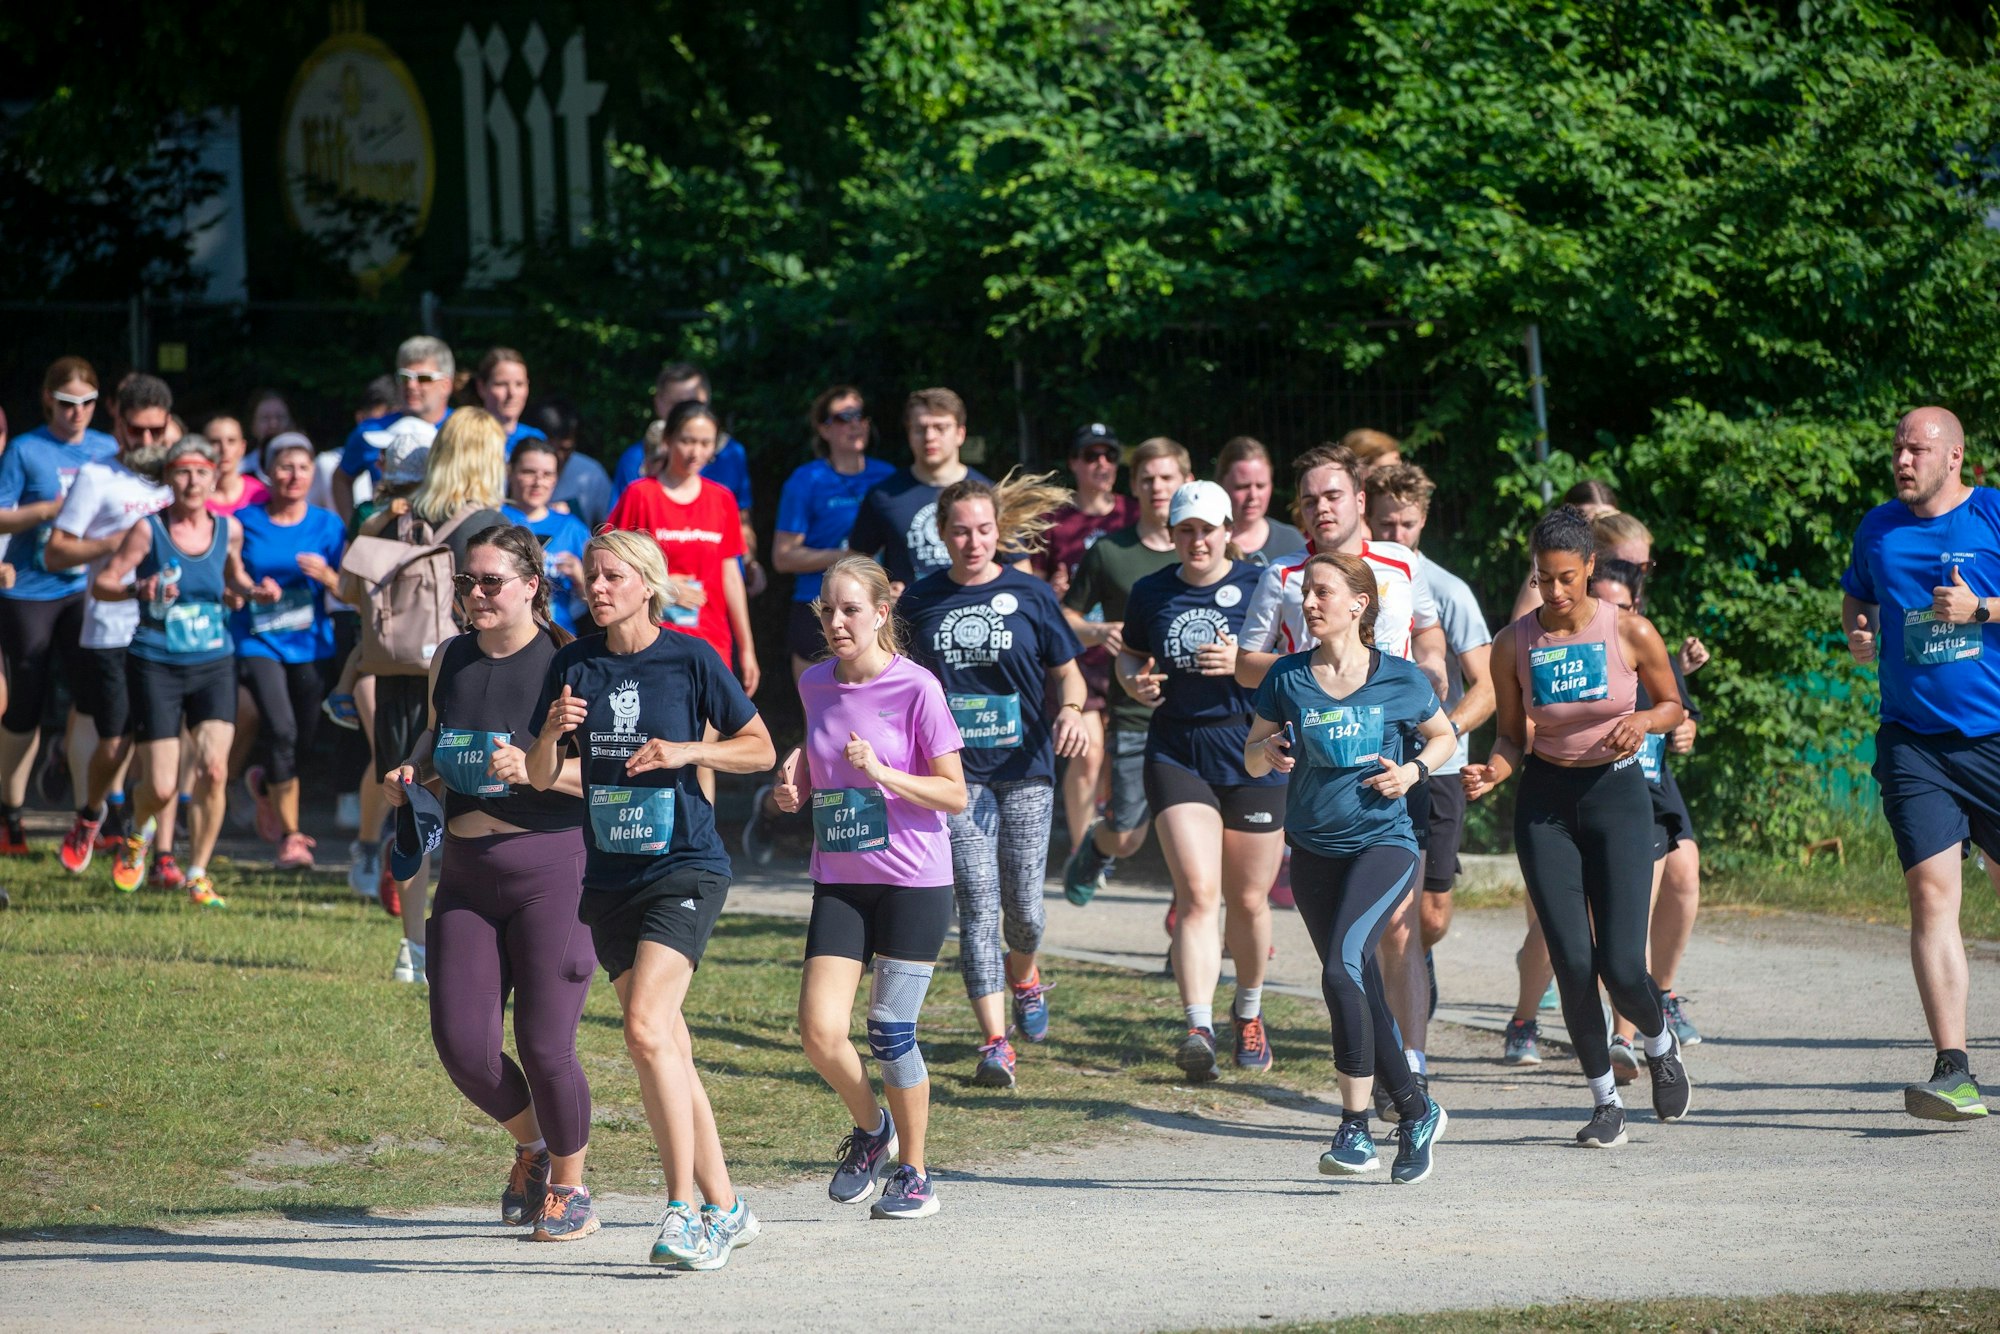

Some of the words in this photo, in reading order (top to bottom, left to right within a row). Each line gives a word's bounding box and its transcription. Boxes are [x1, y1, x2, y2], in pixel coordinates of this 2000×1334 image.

[1920, 611, 1936, 622] LAU
[1931, 622, 1956, 637] 949
[933, 632, 952, 651] 13
[990, 630, 1013, 650] 88
[1163, 637, 1181, 658] 13
[1923, 636, 1967, 655] Justus
[944, 650, 962, 664] ZU
[964, 647, 999, 663] KÖLN
[1553, 659, 1584, 677] 1123
[1551, 676, 1588, 694] Kaira
[975, 710, 998, 724] 765
[1320, 712, 1341, 723] LAUF
[589, 731, 648, 743] Grundschule
[959, 719, 1016, 738] Annabell
[1328, 722, 1360, 740] 1347
[456, 750, 484, 765] 1182
[591, 746, 636, 758] Stenzelbe
[593, 794, 608, 803] UNI
[609, 792, 629, 802] LAUF
[825, 795, 842, 805] LAUF
[618, 806, 644, 822] 870
[834, 806, 857, 823] 671
[610, 824, 654, 841] Meike
[826, 822, 870, 842] Nicola
